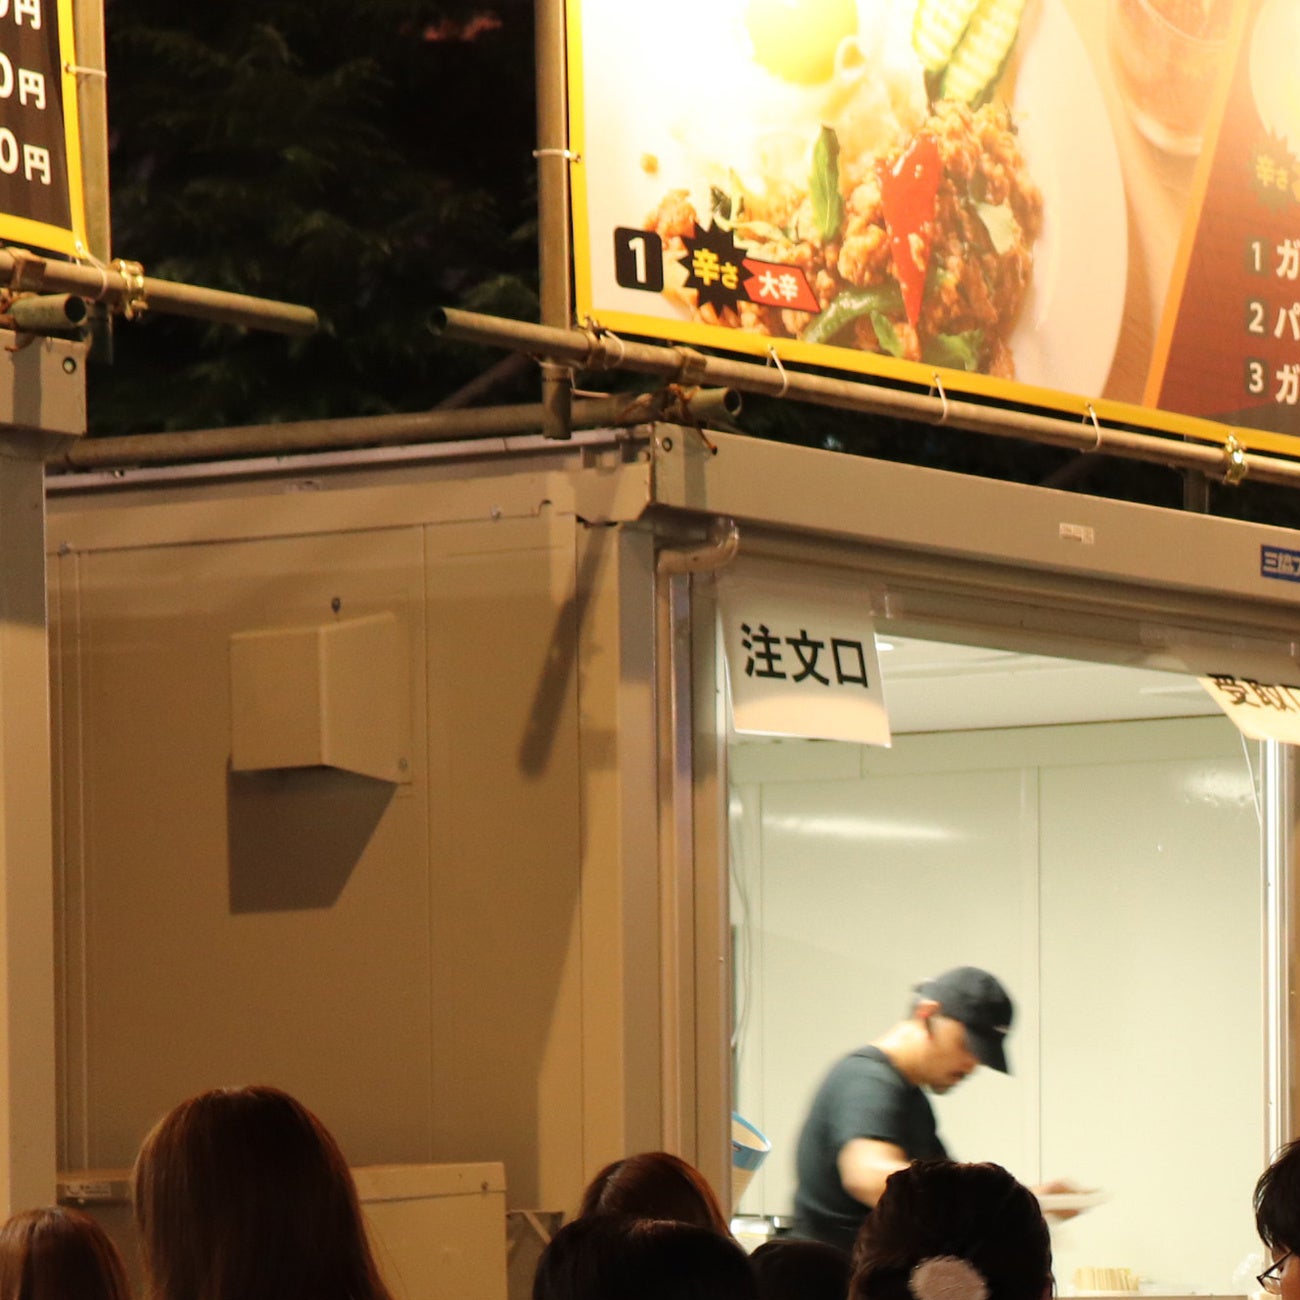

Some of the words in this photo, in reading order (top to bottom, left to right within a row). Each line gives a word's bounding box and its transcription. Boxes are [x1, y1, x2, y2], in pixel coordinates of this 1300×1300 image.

[0, 0, 41, 30] 円
[1256, 154, 1288, 191] 辛さ
[628, 236, 647, 284] 1
[1252, 241, 1261, 272] 1
[692, 248, 739, 290] 辛さ
[758, 270, 799, 302] 大辛
[1249, 302, 1264, 333] 2
[1249, 362, 1264, 393] 3
[741, 623, 869, 688] 注文口
